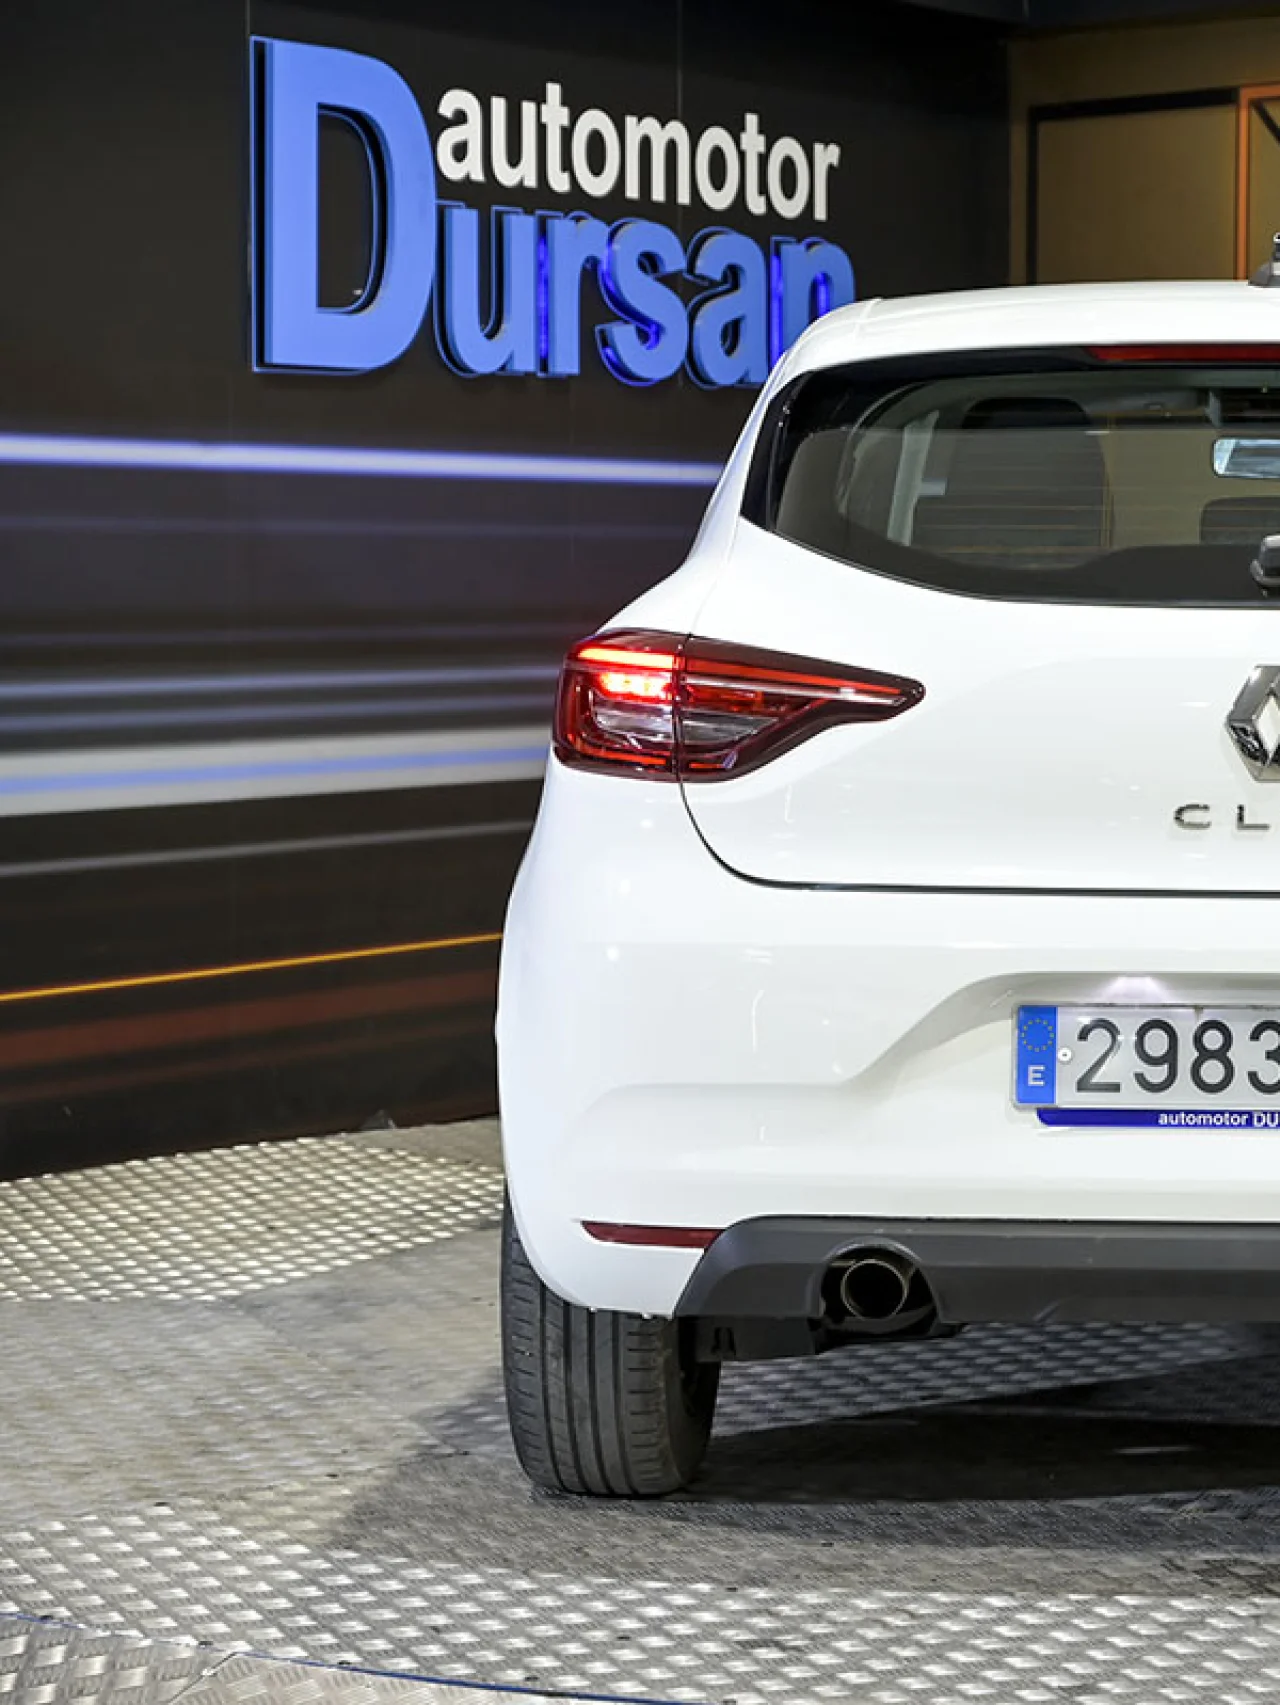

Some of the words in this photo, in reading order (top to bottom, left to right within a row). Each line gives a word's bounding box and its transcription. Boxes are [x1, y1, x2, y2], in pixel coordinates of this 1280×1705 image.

[436, 82, 841, 221] automotor
[250, 35, 855, 388] Dursan
[1027, 1065, 1045, 1086] E
[1158, 1111, 1249, 1126] automotor
